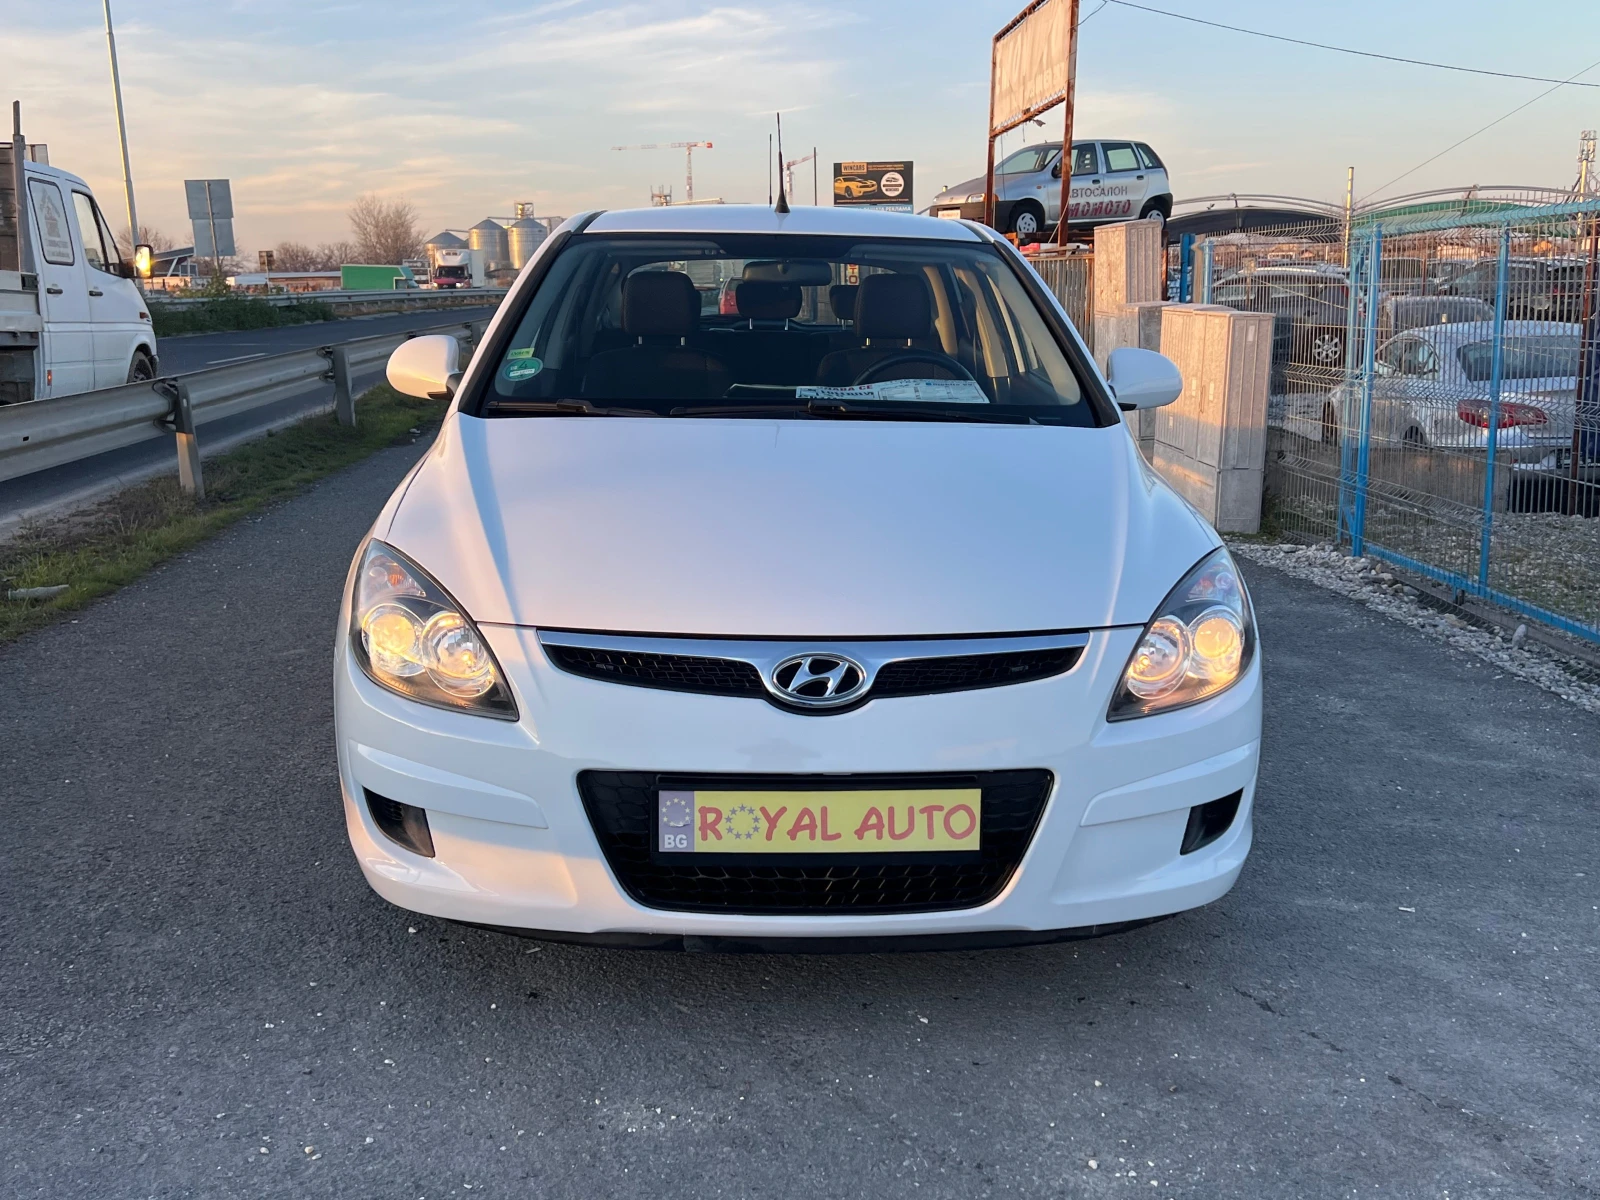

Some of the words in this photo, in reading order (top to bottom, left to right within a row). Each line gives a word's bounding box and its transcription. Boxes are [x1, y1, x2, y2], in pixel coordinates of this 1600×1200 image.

[1069, 186, 1128, 198] ВТОСАЛОН
[698, 803, 842, 841] ROYAL
[854, 803, 977, 841] AUTO
[664, 834, 688, 849] BG
